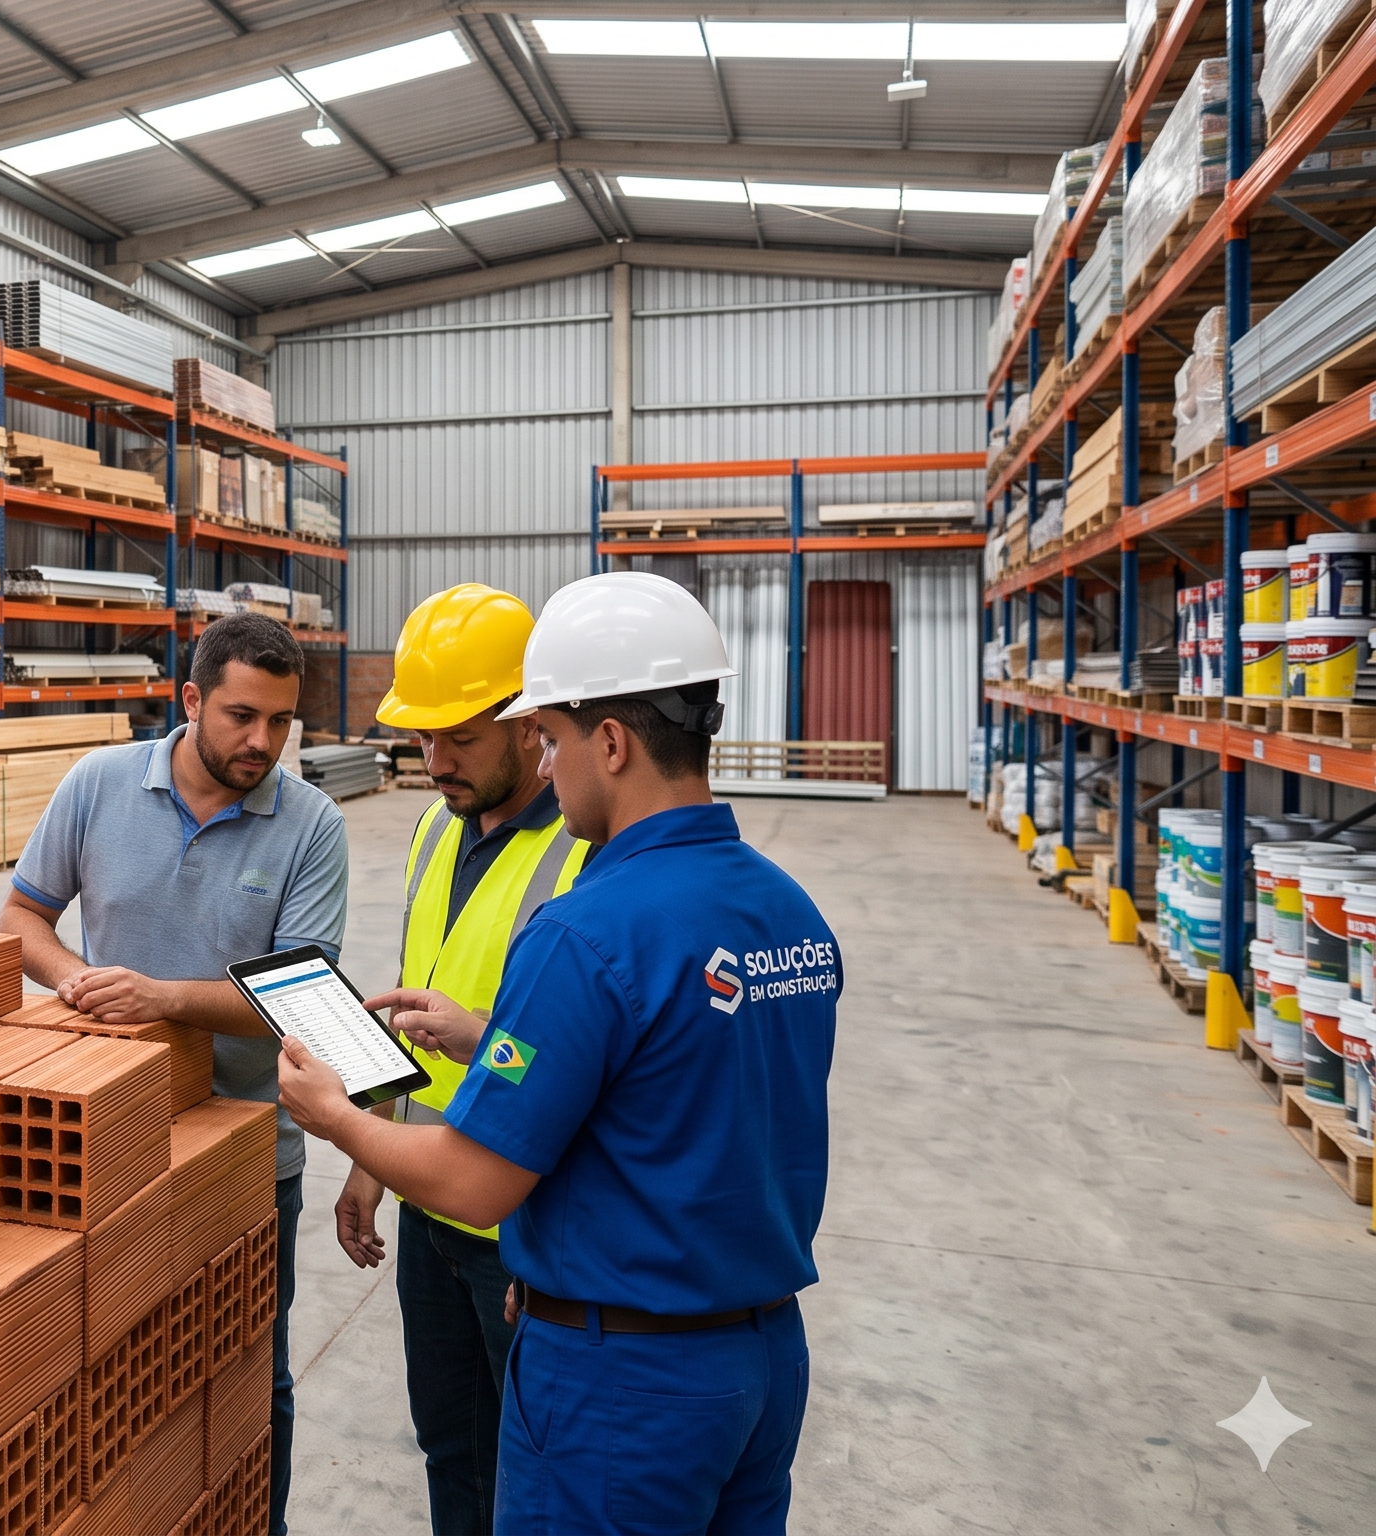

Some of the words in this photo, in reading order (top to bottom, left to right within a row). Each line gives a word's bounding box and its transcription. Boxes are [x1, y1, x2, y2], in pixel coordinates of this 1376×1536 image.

[744, 938, 834, 977] SOLUÇÕES
[749, 984, 765, 1002] EM
[766, 970, 837, 999] CONSTRUÇÃO
